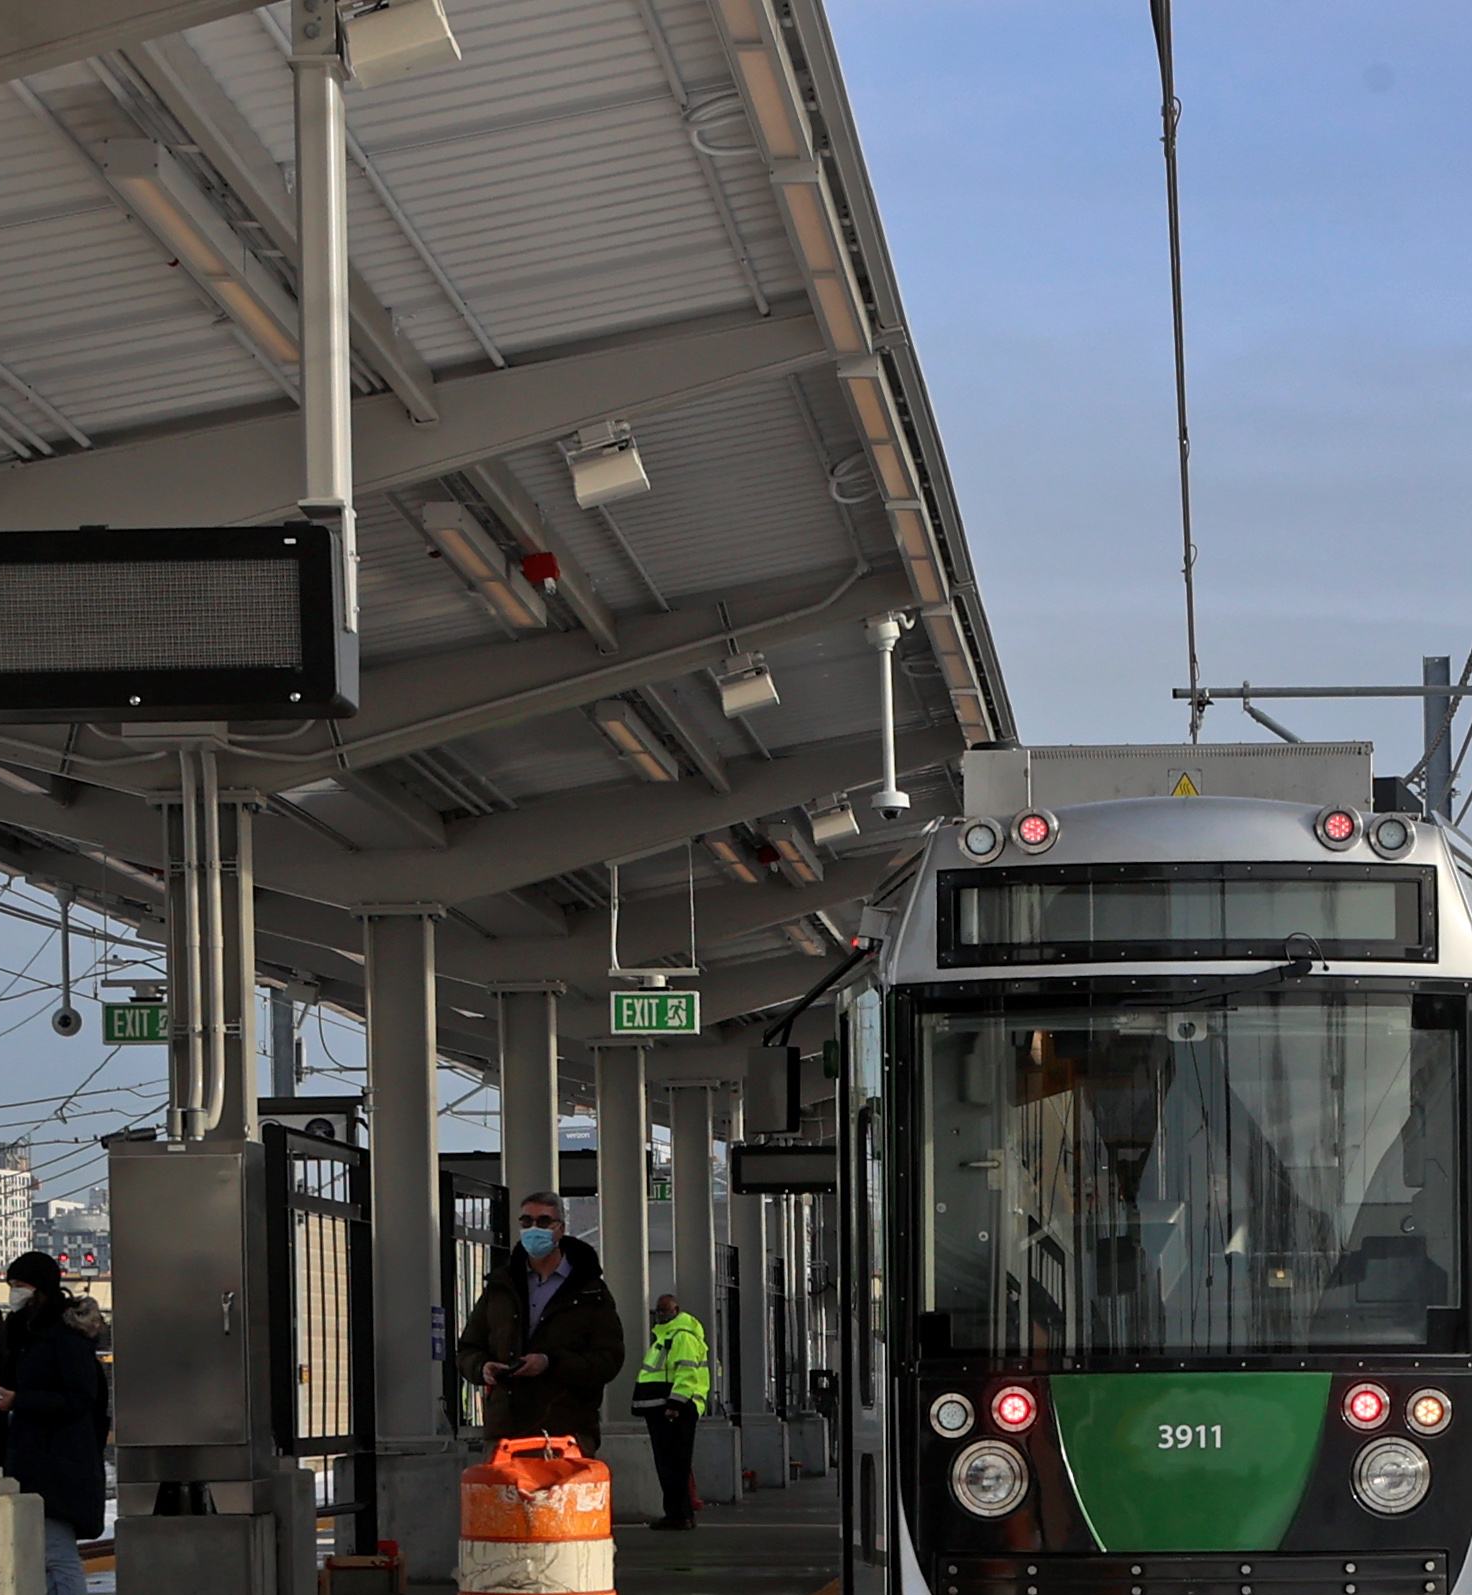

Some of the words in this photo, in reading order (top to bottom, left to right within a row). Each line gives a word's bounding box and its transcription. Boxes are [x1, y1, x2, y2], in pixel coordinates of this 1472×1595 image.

[113, 1008, 151, 1037] EXIT
[623, 998, 659, 1027] EXIT
[1158, 1424, 1221, 1449] 3911
